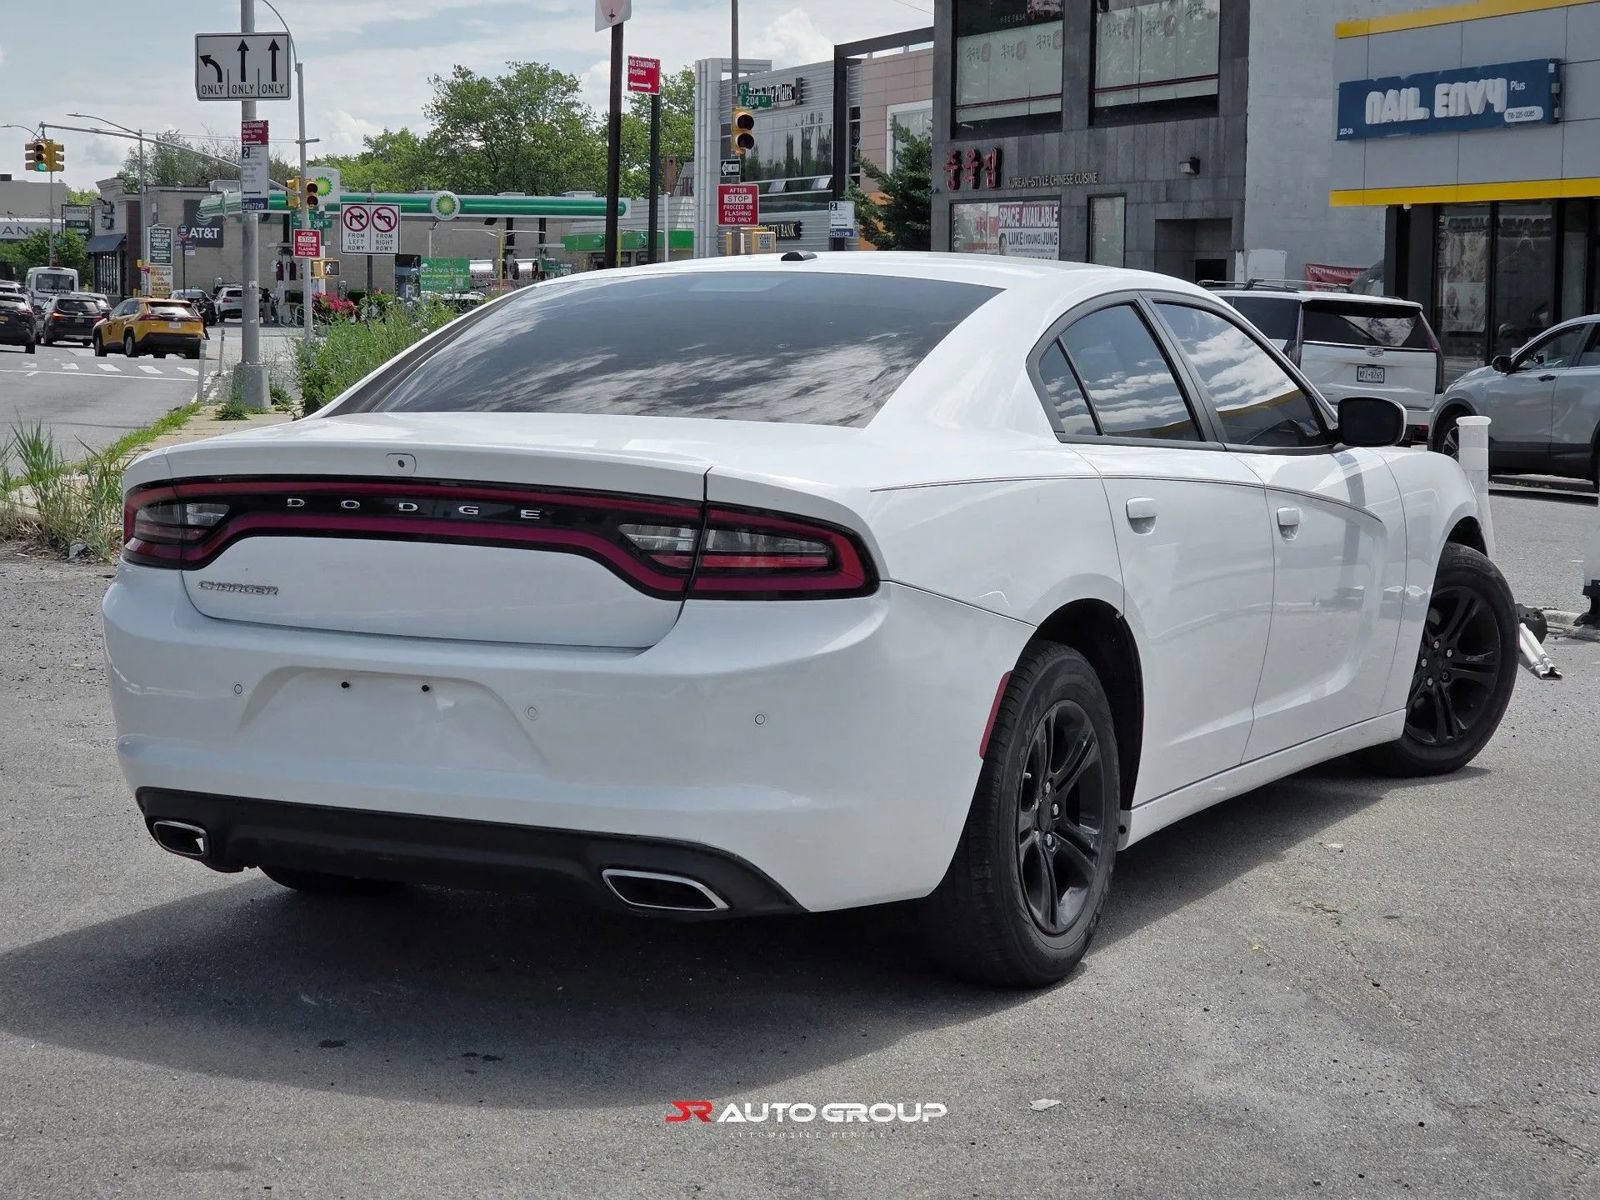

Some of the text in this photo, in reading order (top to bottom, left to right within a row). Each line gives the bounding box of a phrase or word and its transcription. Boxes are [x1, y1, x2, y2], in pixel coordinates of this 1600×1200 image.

[636, 60, 656, 68] STANDING
[201, 85, 224, 94] ONLY
[231, 84, 254, 94] ONLY
[261, 83, 285, 94] ONLY
[1510, 80, 1526, 91] Plus
[745, 95, 759, 106] 204
[999, 205, 1059, 227] SPACE AVAILABLE
[188, 227, 220, 239] AT&T
[780, 224, 796, 237] BANK
[1008, 232, 1023, 245] LUKE
[1042, 232, 1058, 246] JUNG
[287, 498, 541, 520] DODGE
[198, 580, 279, 596] CHARGER
